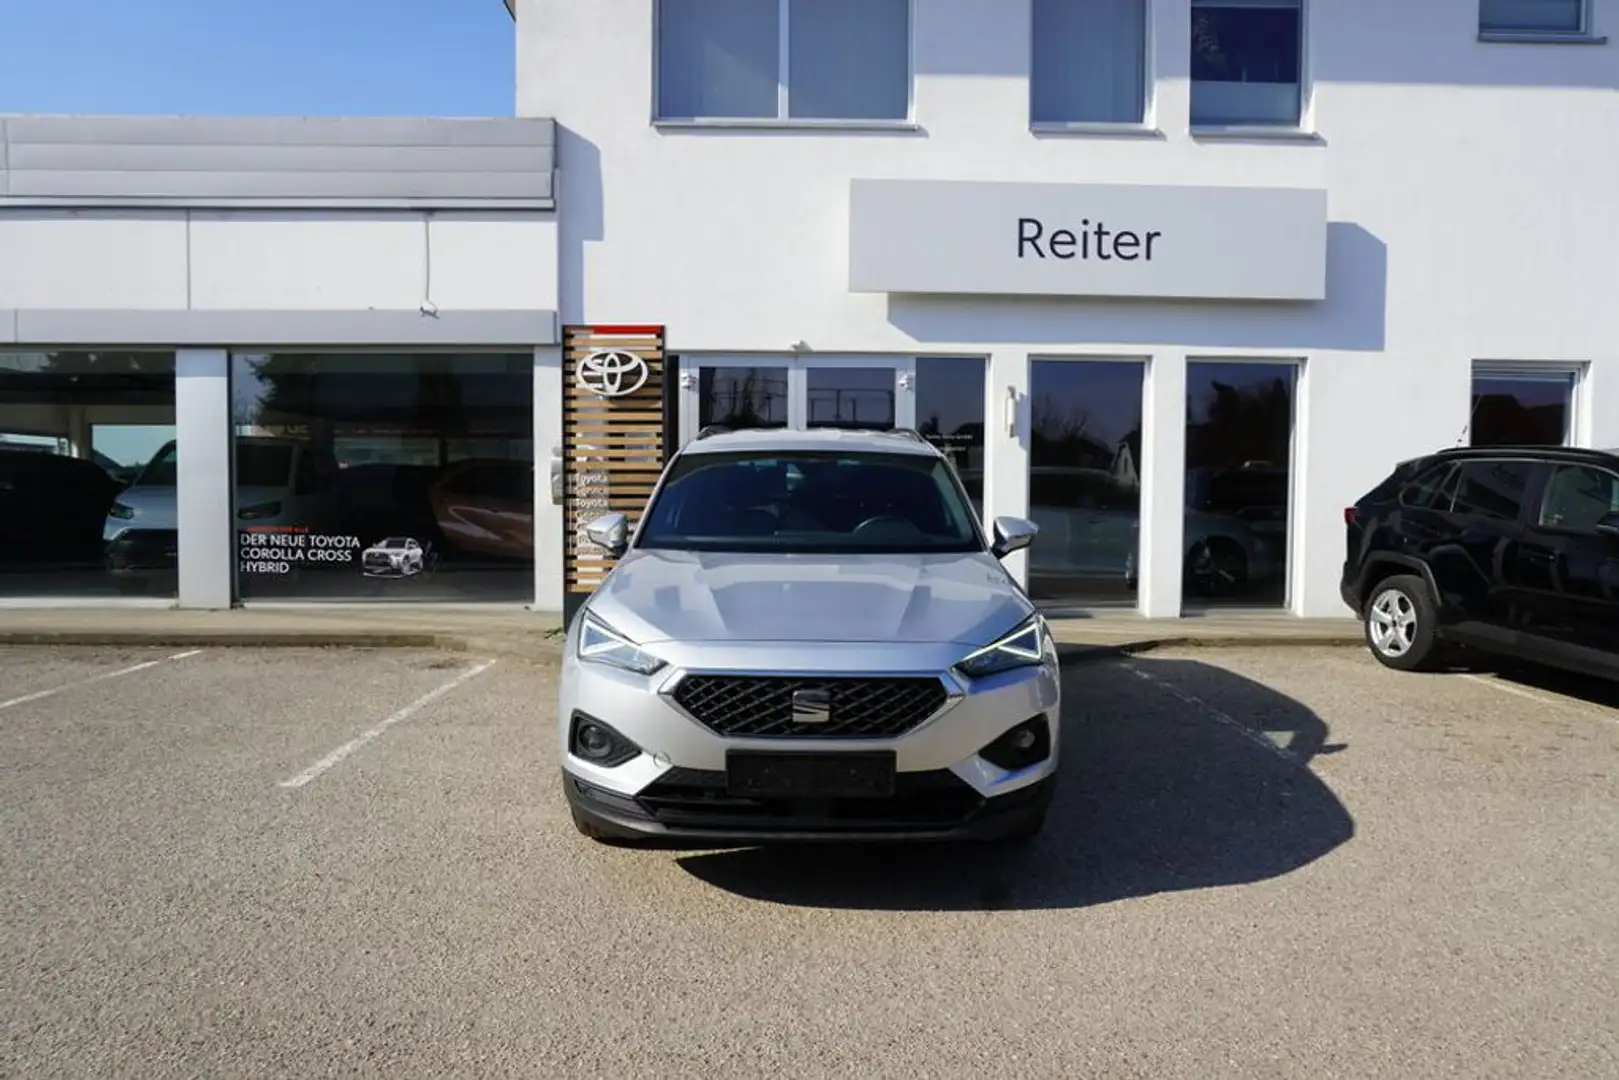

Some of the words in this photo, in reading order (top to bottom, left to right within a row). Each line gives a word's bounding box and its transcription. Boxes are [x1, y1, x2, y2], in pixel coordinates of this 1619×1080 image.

[1018, 217, 1161, 261] Reiter
[240, 533, 267, 546] DER
[270, 534, 305, 547] NEUE
[308, 535, 361, 548] TOYOTA
[240, 547, 305, 560] COROLLA
[307, 549, 352, 561] CROSS
[240, 561, 290, 574] HYBRID
